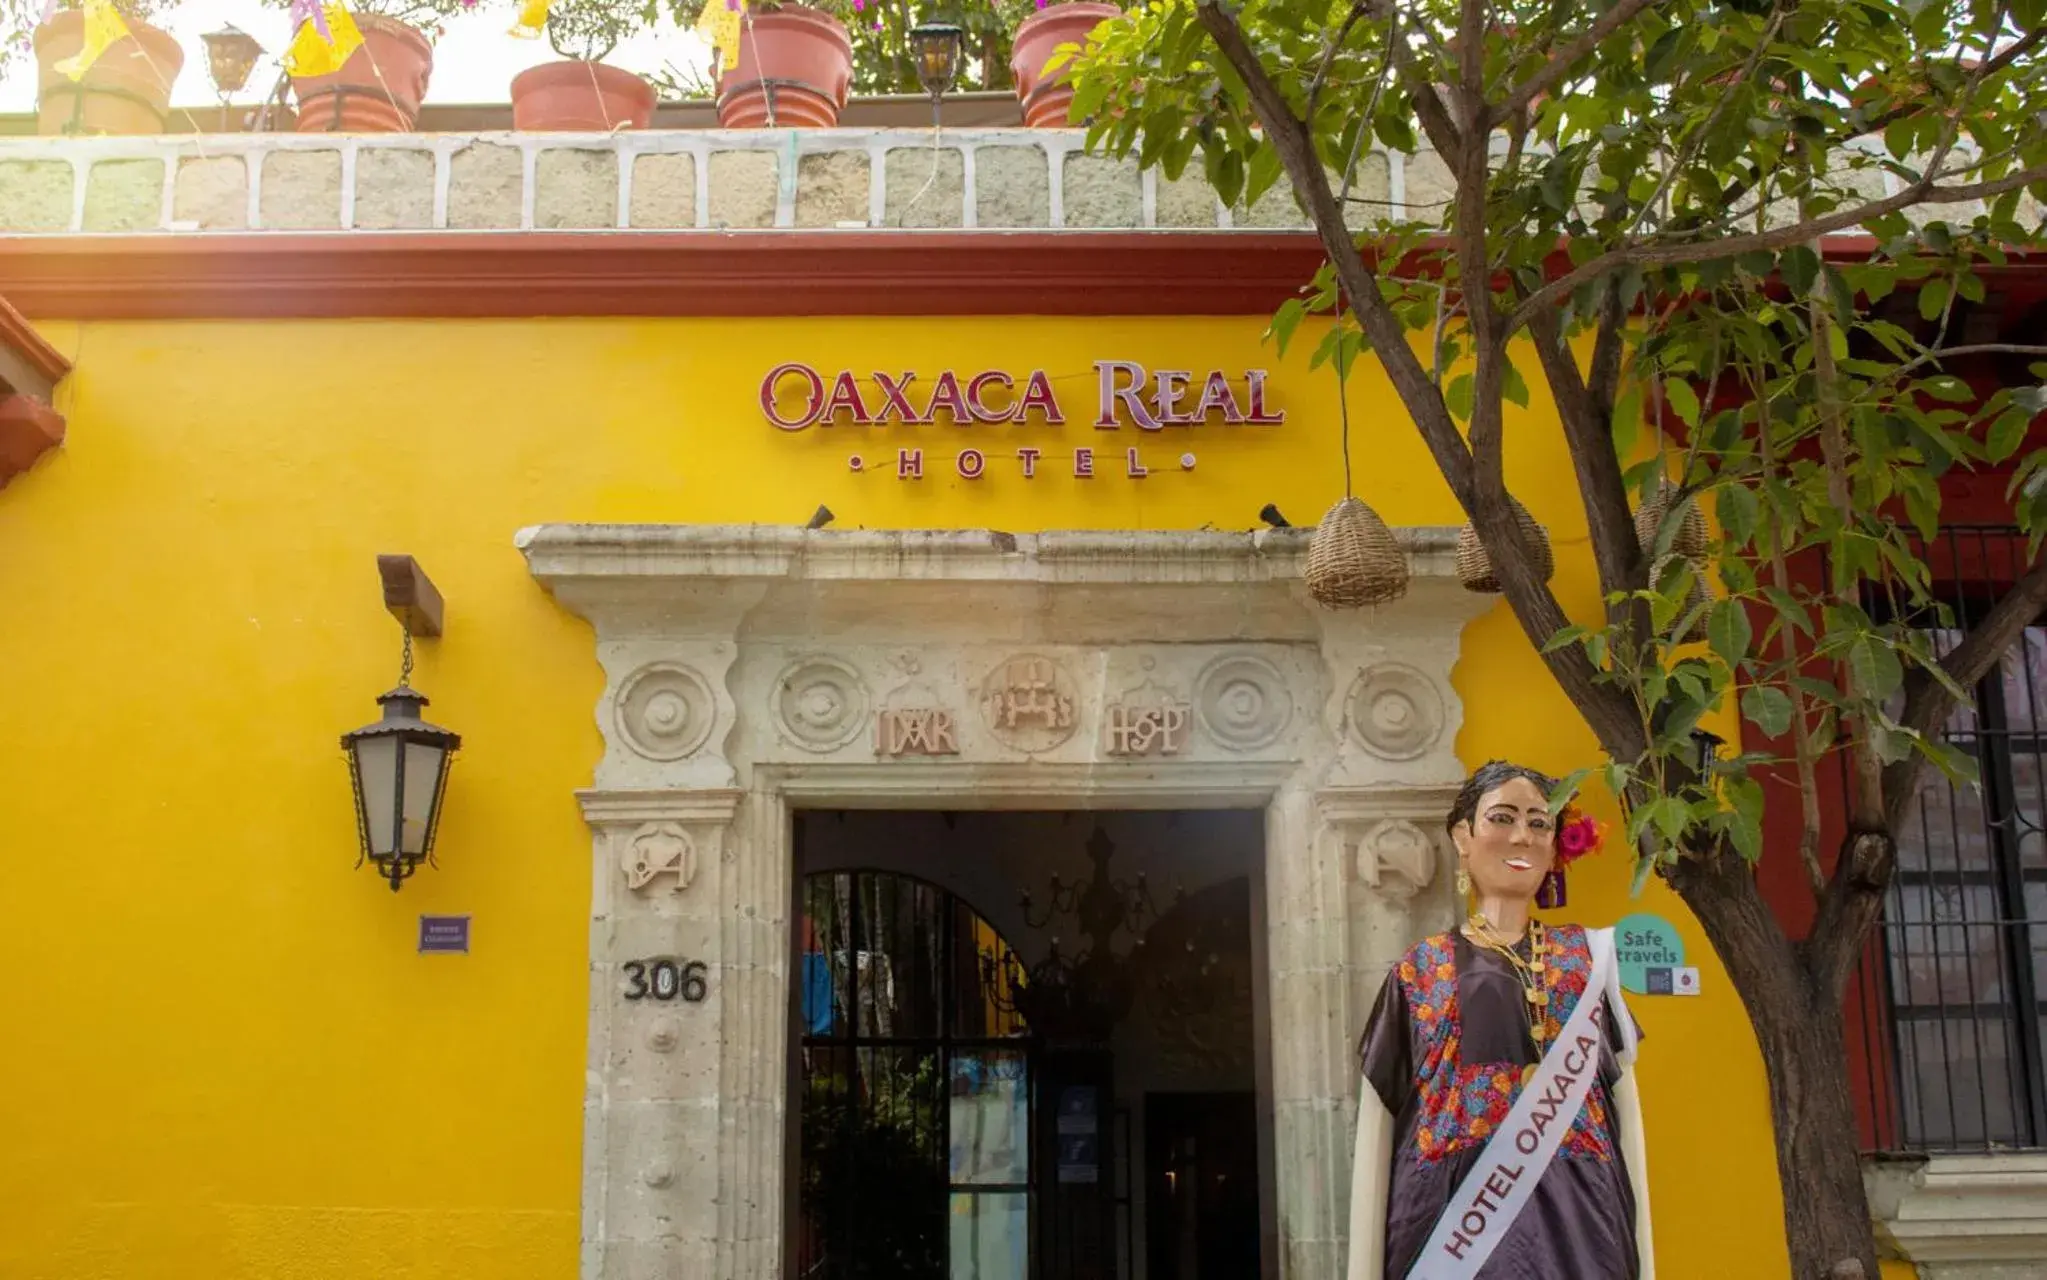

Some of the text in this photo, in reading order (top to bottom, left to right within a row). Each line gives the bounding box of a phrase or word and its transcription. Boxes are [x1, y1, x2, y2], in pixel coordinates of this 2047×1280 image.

[759, 360, 1284, 431] OAXACA REAL
[897, 447, 1148, 477] HOTEL
[1616, 946, 1678, 963] travels
[1623, 929, 1663, 947] Safe
[623, 958, 708, 1003] 306
[1443, 1034, 1597, 1261] HOTEL OAXACA
